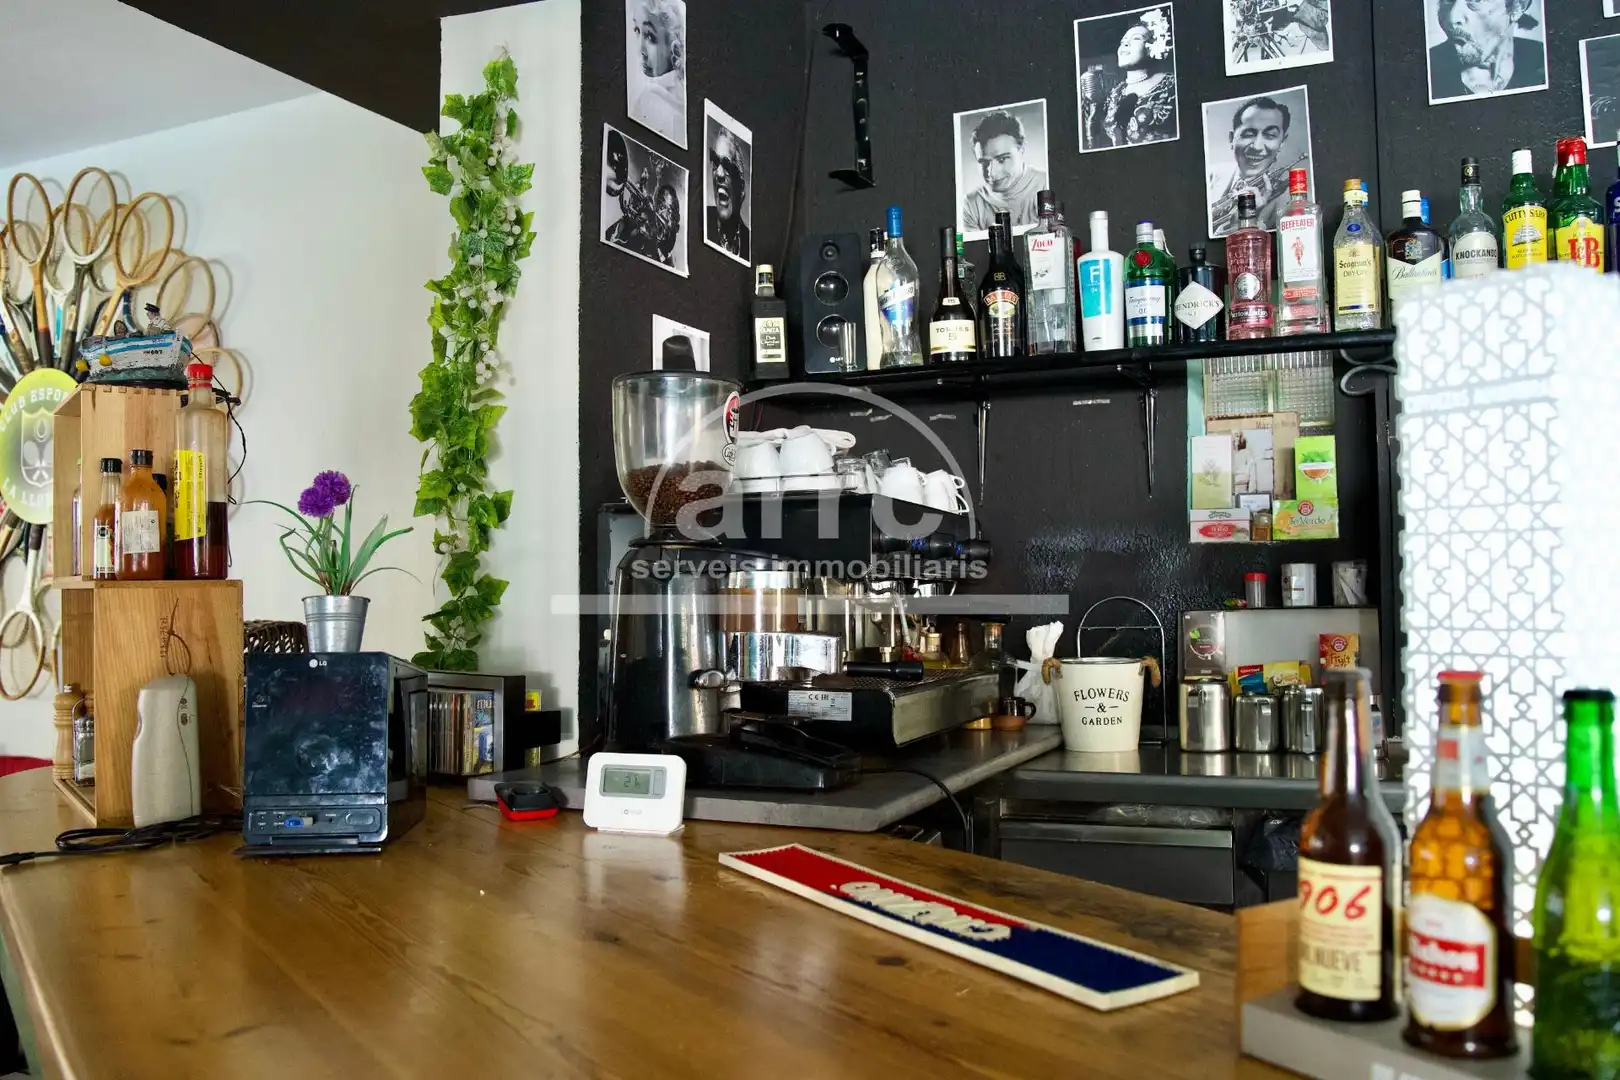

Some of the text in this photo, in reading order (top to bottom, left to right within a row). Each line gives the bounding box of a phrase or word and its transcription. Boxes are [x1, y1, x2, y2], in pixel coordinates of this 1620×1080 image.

[1504, 209, 1526, 224] CUTTY
[1281, 219, 1315, 231] BEEFEATER
[1338, 258, 1372, 269] Seagram's
[1392, 266, 1438, 281] Ballantine's
[985, 290, 1017, 305] BAEYS
[1128, 296, 1162, 305] Tanquay
[935, 325, 970, 334] TOES
[1073, 687, 1130, 702] FLOWERS
[1096, 702, 1107, 713] &
[1081, 716, 1123, 726] GARDEN
